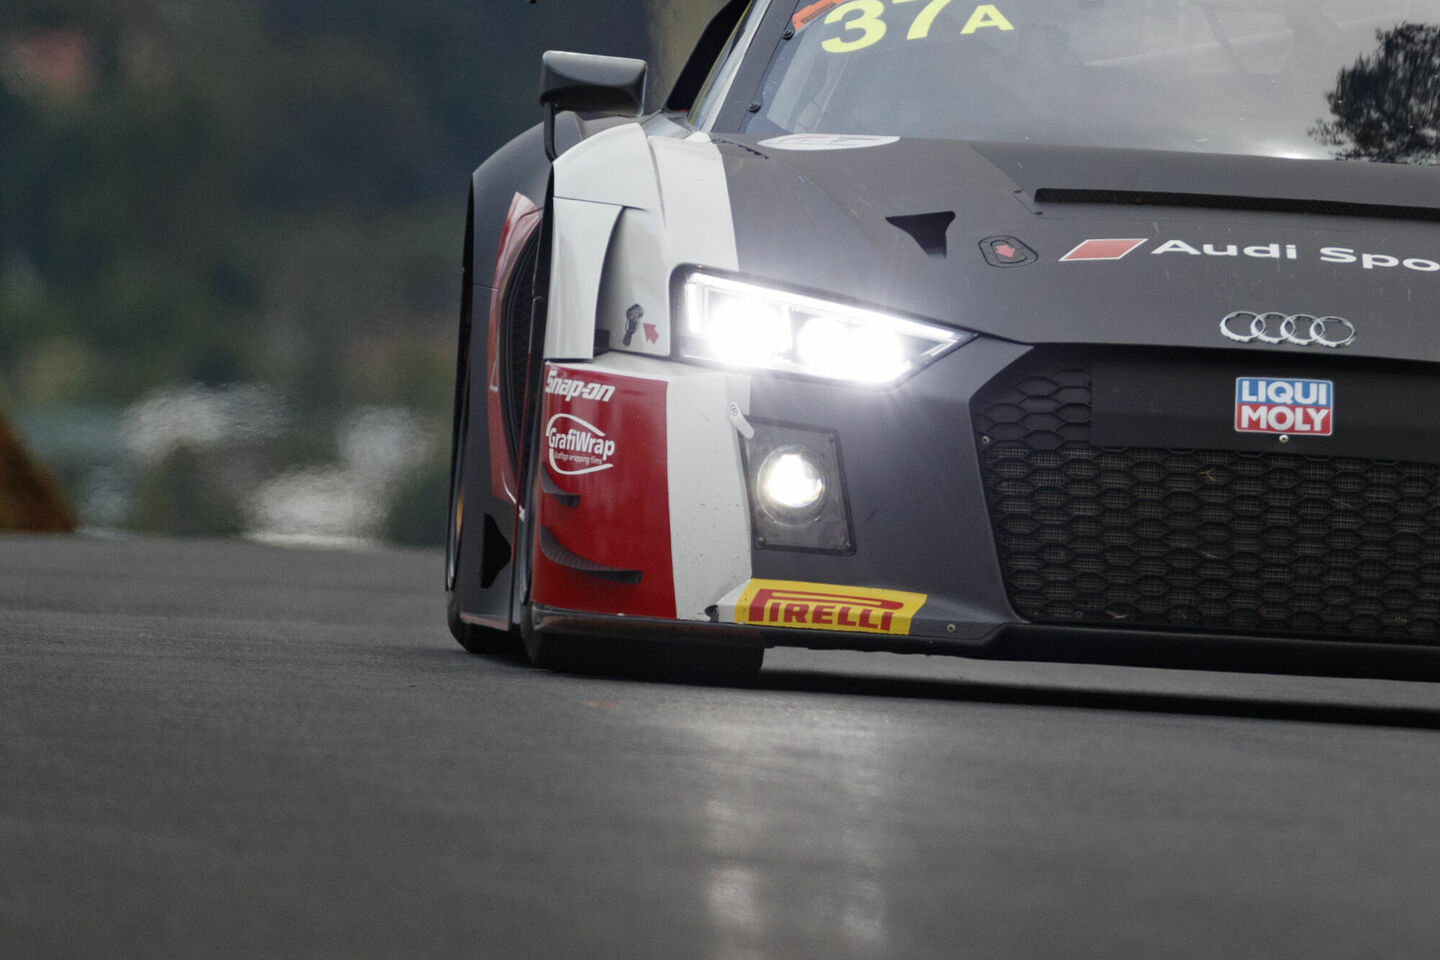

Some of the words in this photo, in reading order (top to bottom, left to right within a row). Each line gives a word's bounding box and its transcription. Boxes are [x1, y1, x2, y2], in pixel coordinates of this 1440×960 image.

[1151, 240, 1297, 259] Audi
[545, 370, 616, 402] Snap-on
[1242, 380, 1327, 405] LIQUI
[1241, 405, 1330, 431] MOLY
[548, 427, 616, 461] GrafiWrap
[748, 588, 904, 631] PIRELLI
